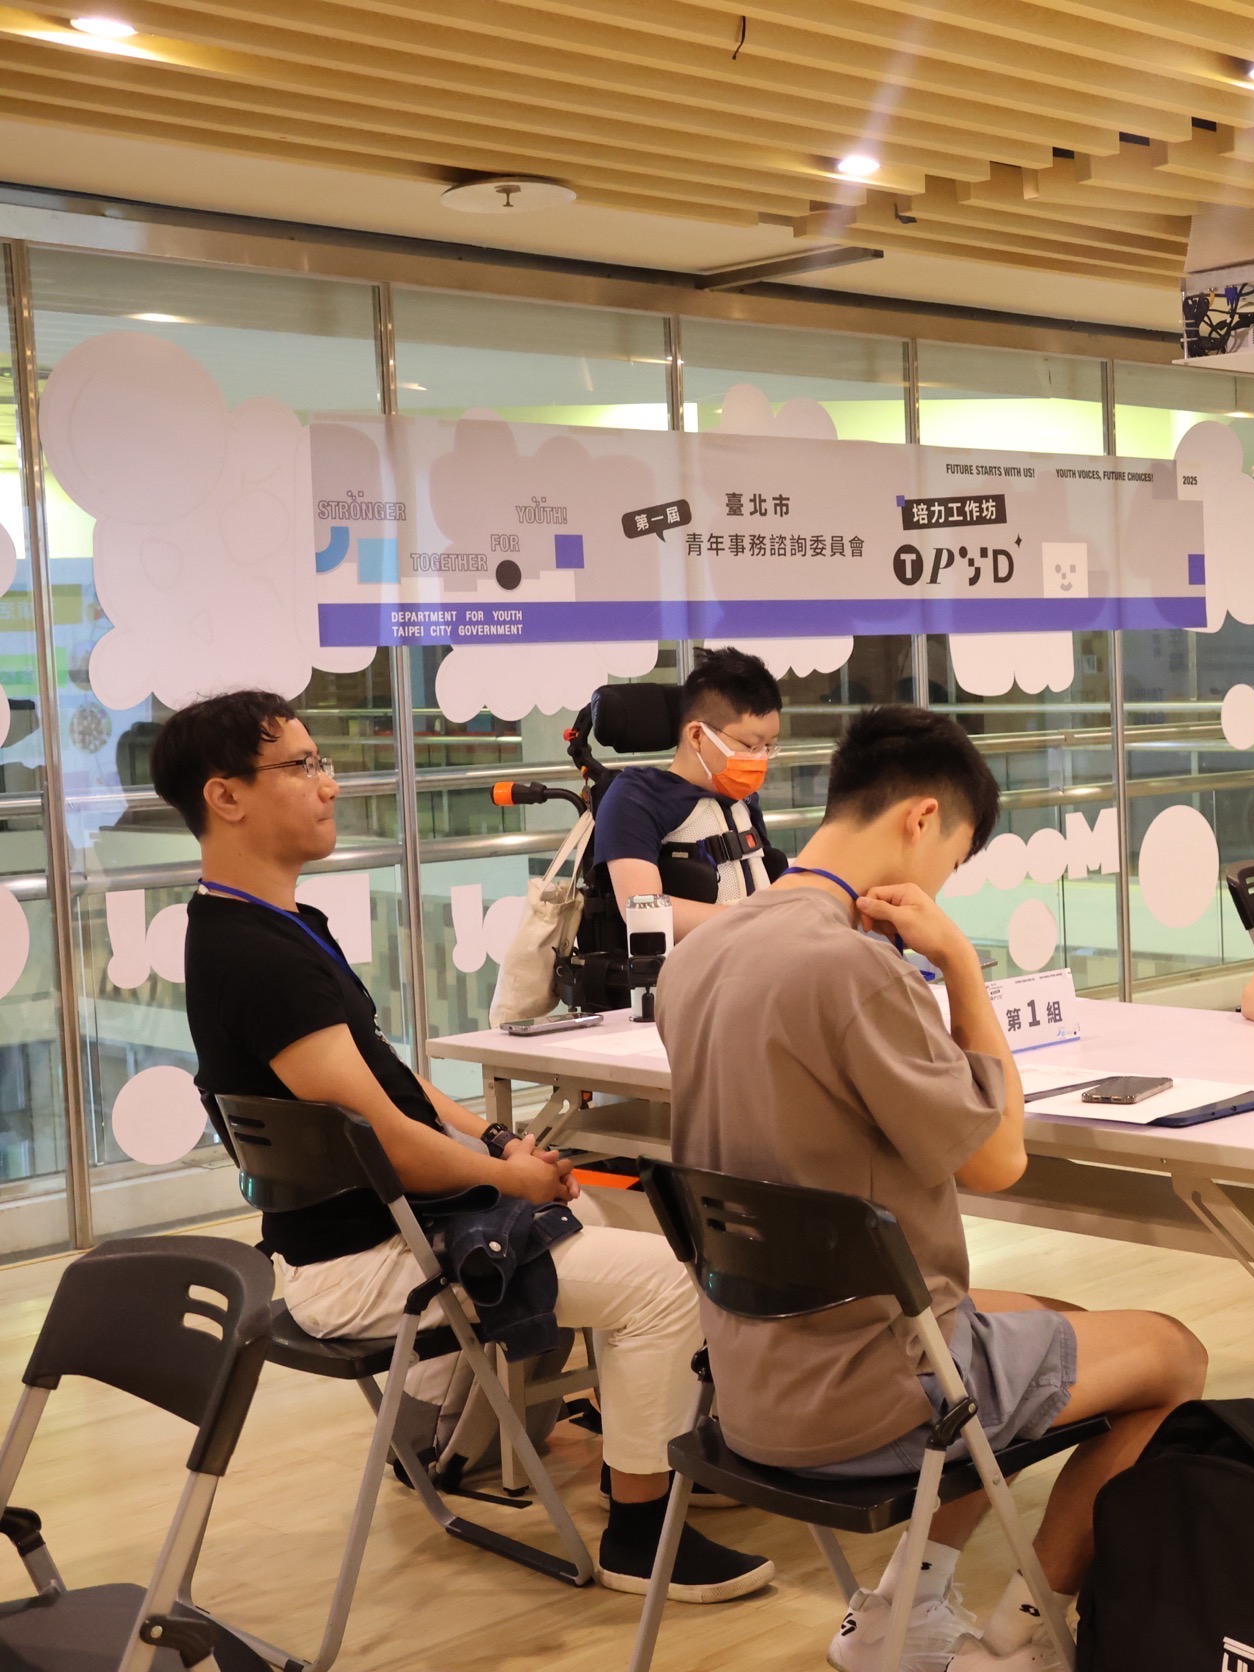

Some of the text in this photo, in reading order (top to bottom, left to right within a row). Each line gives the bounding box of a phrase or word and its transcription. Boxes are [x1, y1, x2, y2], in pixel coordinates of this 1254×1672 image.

[946, 464, 1035, 477] FUTURE STARTS WITH US!
[1056, 469, 1153, 482] YOUTH VOICES, FUTURE CHOICES!
[1183, 476, 1197, 485] 2025
[318, 501, 406, 520] STRONGER
[726, 493, 790, 517] 臺北市
[913, 499, 996, 524] 培力工作坊
[516, 505, 567, 524] YOUTH!
[635, 506, 680, 531] 第一屆
[491, 534, 519, 552] FOR
[686, 533, 864, 557] 青年事務諮詢委員會
[410, 553, 488, 571] TOGETHER
[392, 611, 522, 622] DEPARTMENT FOR YOUTH
[392, 625, 522, 636] TAIPEI CITY GOVERNMENT
[1006, 999, 1062, 1032] 第1組
